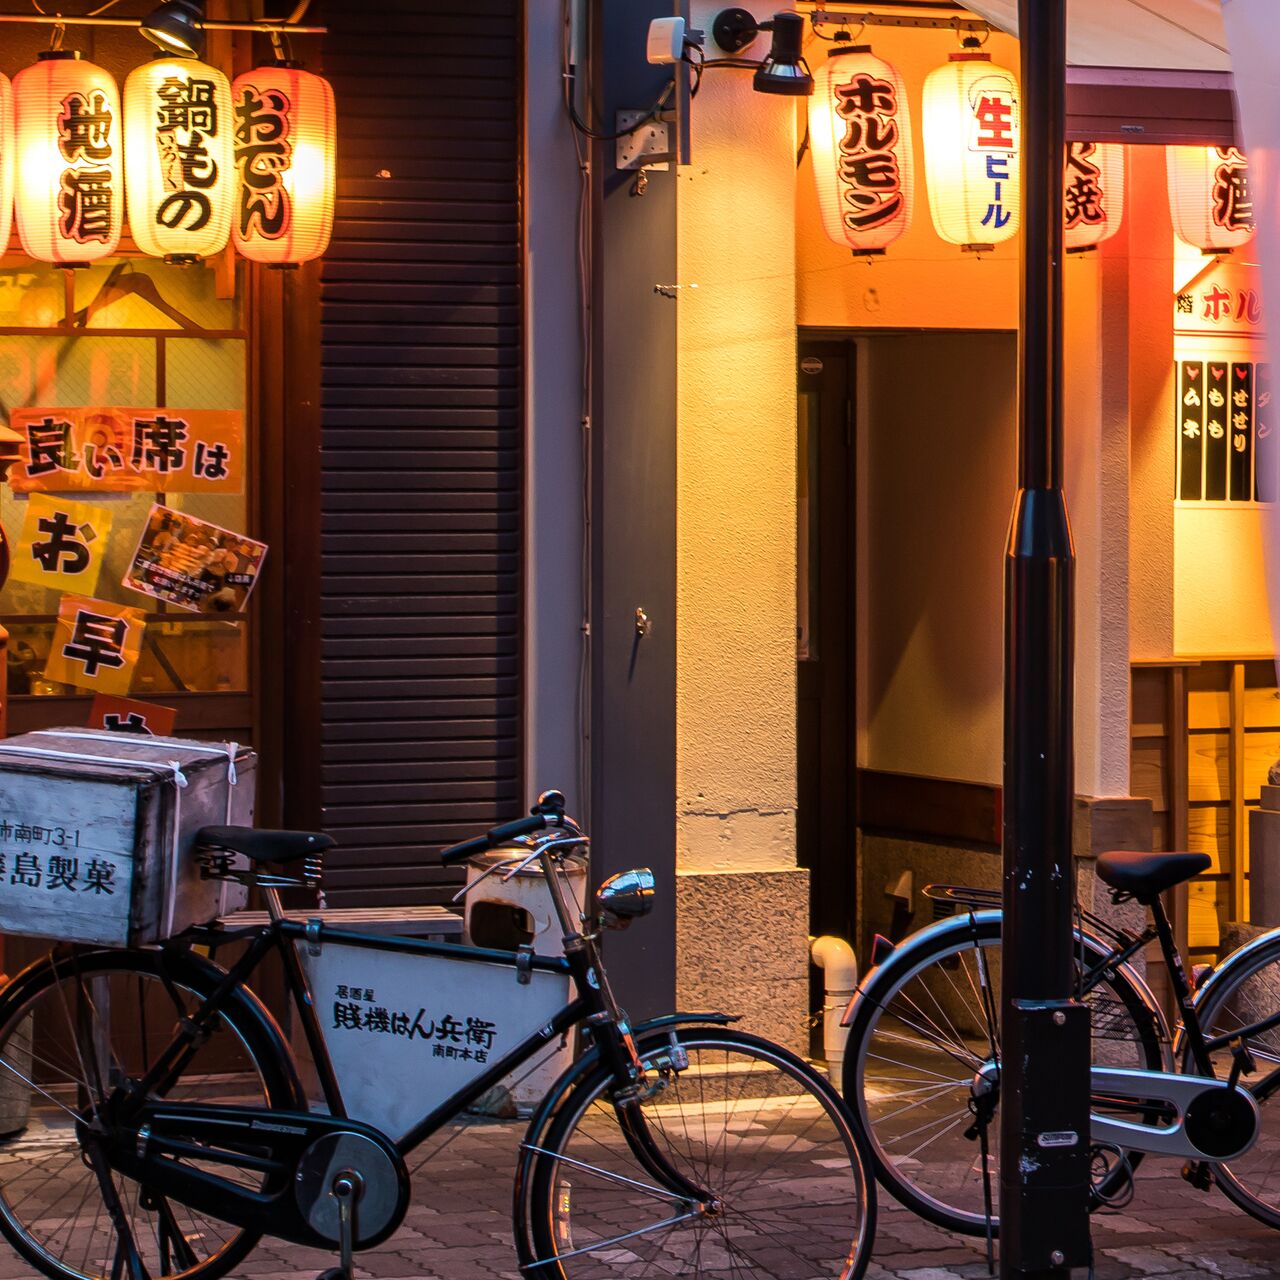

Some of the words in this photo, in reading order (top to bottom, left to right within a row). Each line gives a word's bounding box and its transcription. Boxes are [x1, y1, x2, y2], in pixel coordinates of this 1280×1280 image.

[58, 88, 113, 244] 地酒
[156, 76, 218, 232] 鍋もの
[232, 83, 292, 242] おでん
[834, 71, 903, 233] ホルモン
[976, 96, 1014, 230] 生ビール
[1208, 388, 1225, 440] もも
[1232, 389, 1249, 453] せせり
[26, 416, 231, 480] 良い席は
[32, 511, 98, 575] お
[62, 609, 129, 677] 早
[335, 985, 376, 1003] 居酒屋
[432, 1043, 489, 1064] 南町本店
